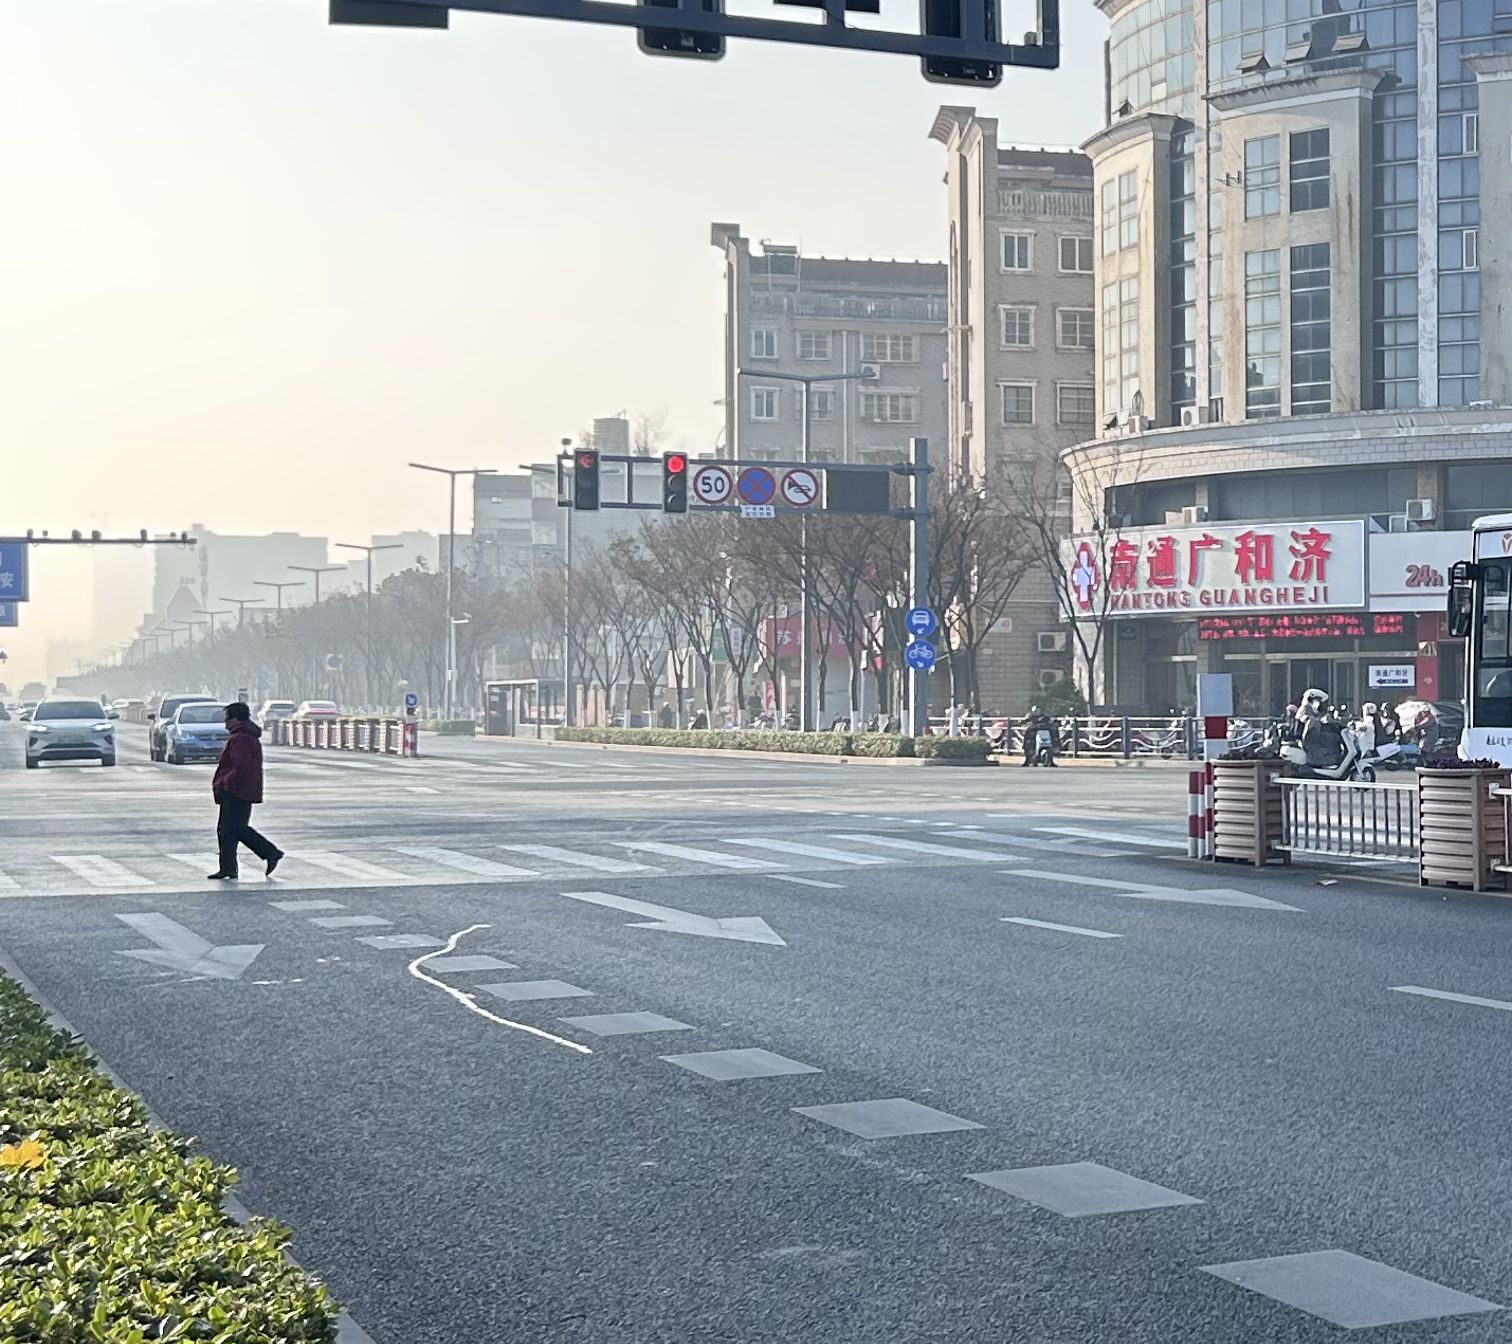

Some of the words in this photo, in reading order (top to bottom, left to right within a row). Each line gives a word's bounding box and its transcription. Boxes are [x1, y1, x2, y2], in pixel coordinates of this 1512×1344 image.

[701, 476, 725, 494] 50
[1110, 527, 1332, 590] 南通广和济
[1405, 564, 1444, 588] 24h
[1111, 591, 1191, 609] NANTONG
[1200, 585, 1329, 606] GUANGHEJI
